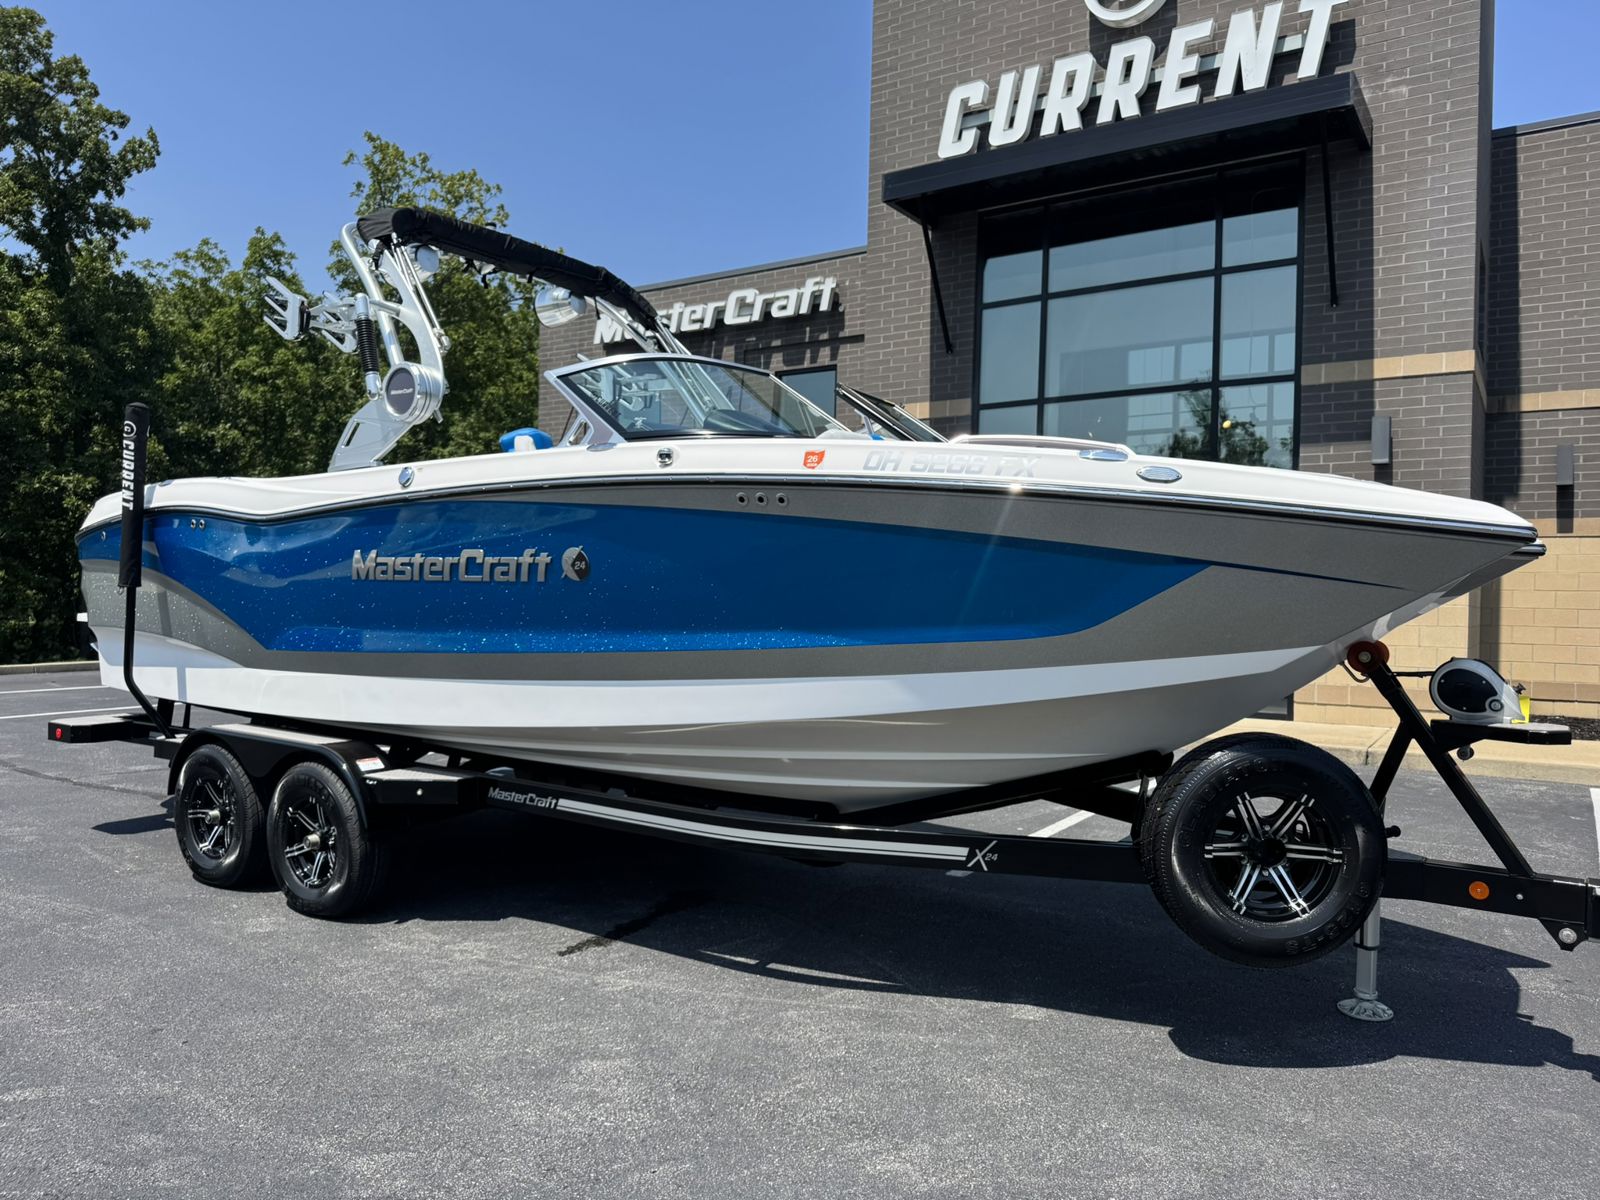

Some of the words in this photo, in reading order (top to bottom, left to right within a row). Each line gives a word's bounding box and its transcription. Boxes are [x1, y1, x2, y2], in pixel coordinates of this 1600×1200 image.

[937, 0, 1348, 159] CURRENT
[807, 455, 818, 463] 26
[862, 450, 906, 471] OH
[994, 455, 1041, 478] FX
[121, 440, 135, 511] CURRENT
[351, 549, 552, 582] MasterCraft
[574, 560, 586, 570] 24
[488, 786, 557, 809] MasterCraft
